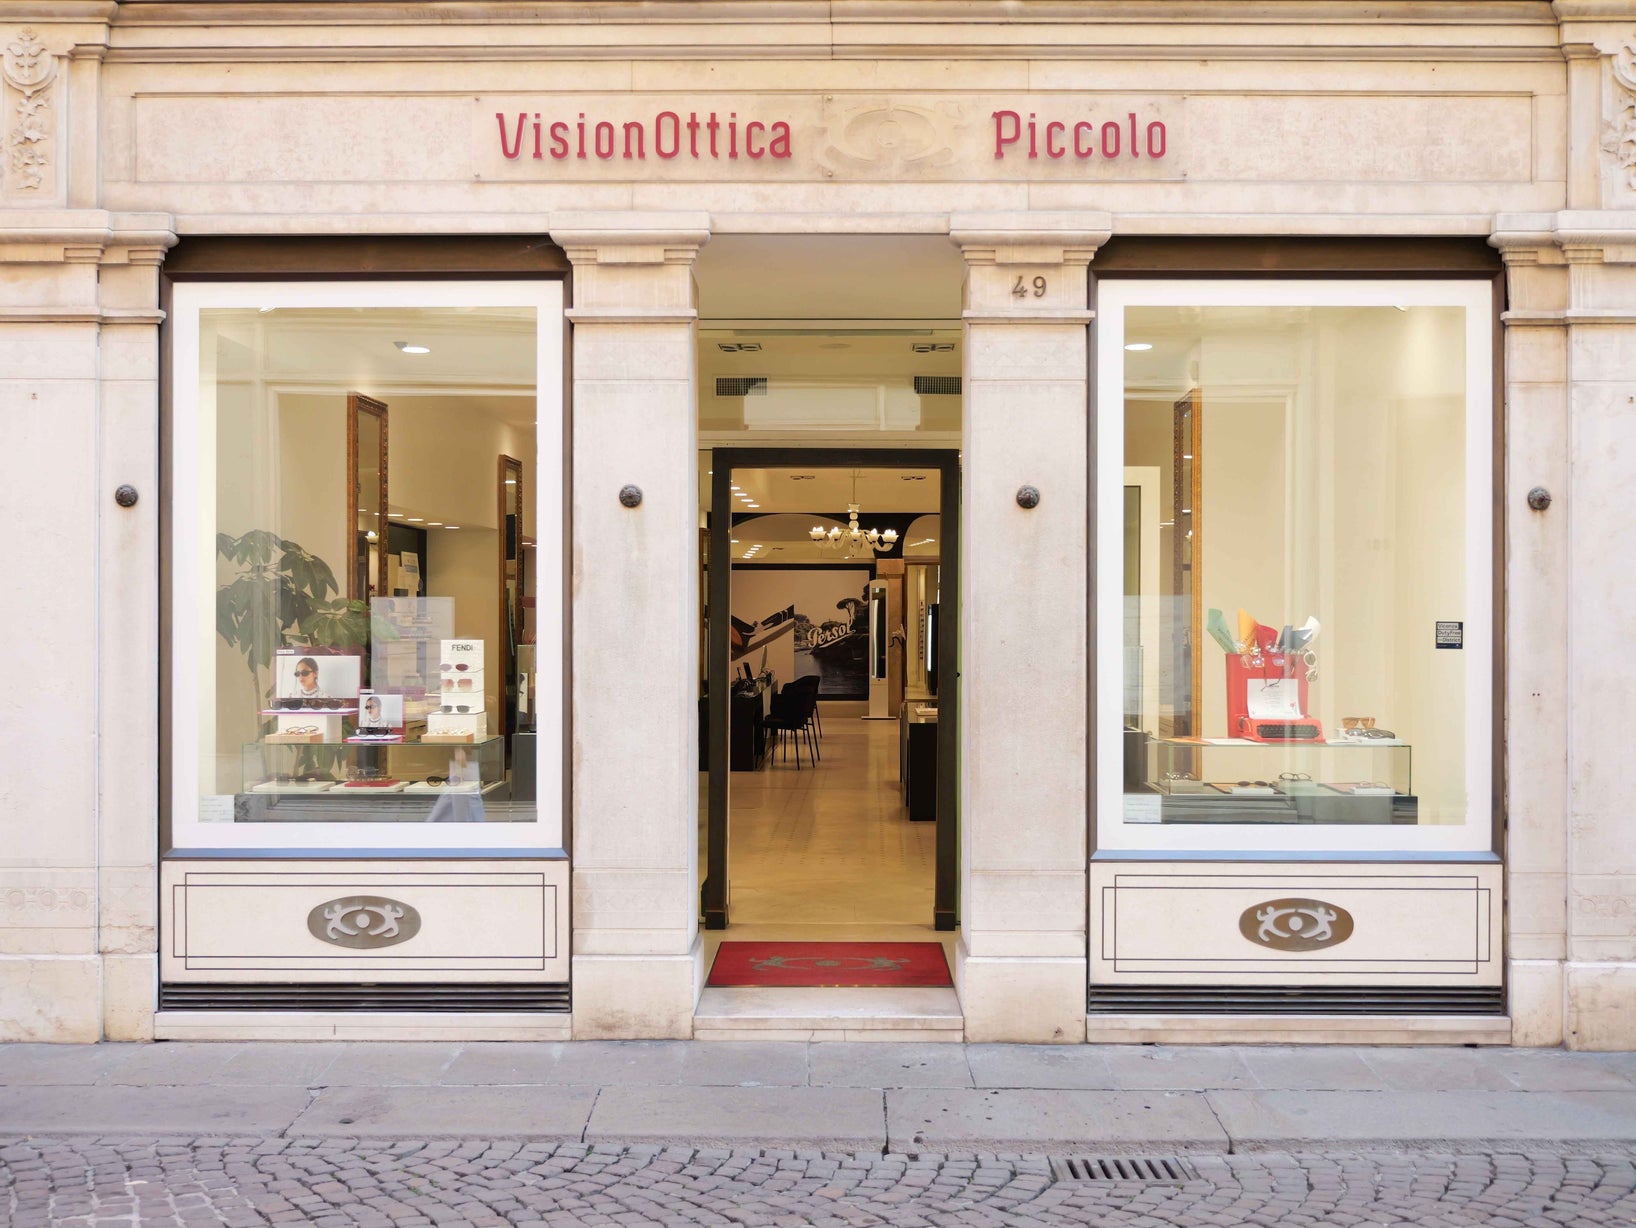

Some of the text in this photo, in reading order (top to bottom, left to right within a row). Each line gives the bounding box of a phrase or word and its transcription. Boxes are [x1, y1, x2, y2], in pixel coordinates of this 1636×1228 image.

[495, 110, 1166, 160] VisionOttica Piccolo
[1011, 275, 1047, 298] 49
[807, 614, 857, 648] Persol
[451, 644, 474, 652] FENDI
